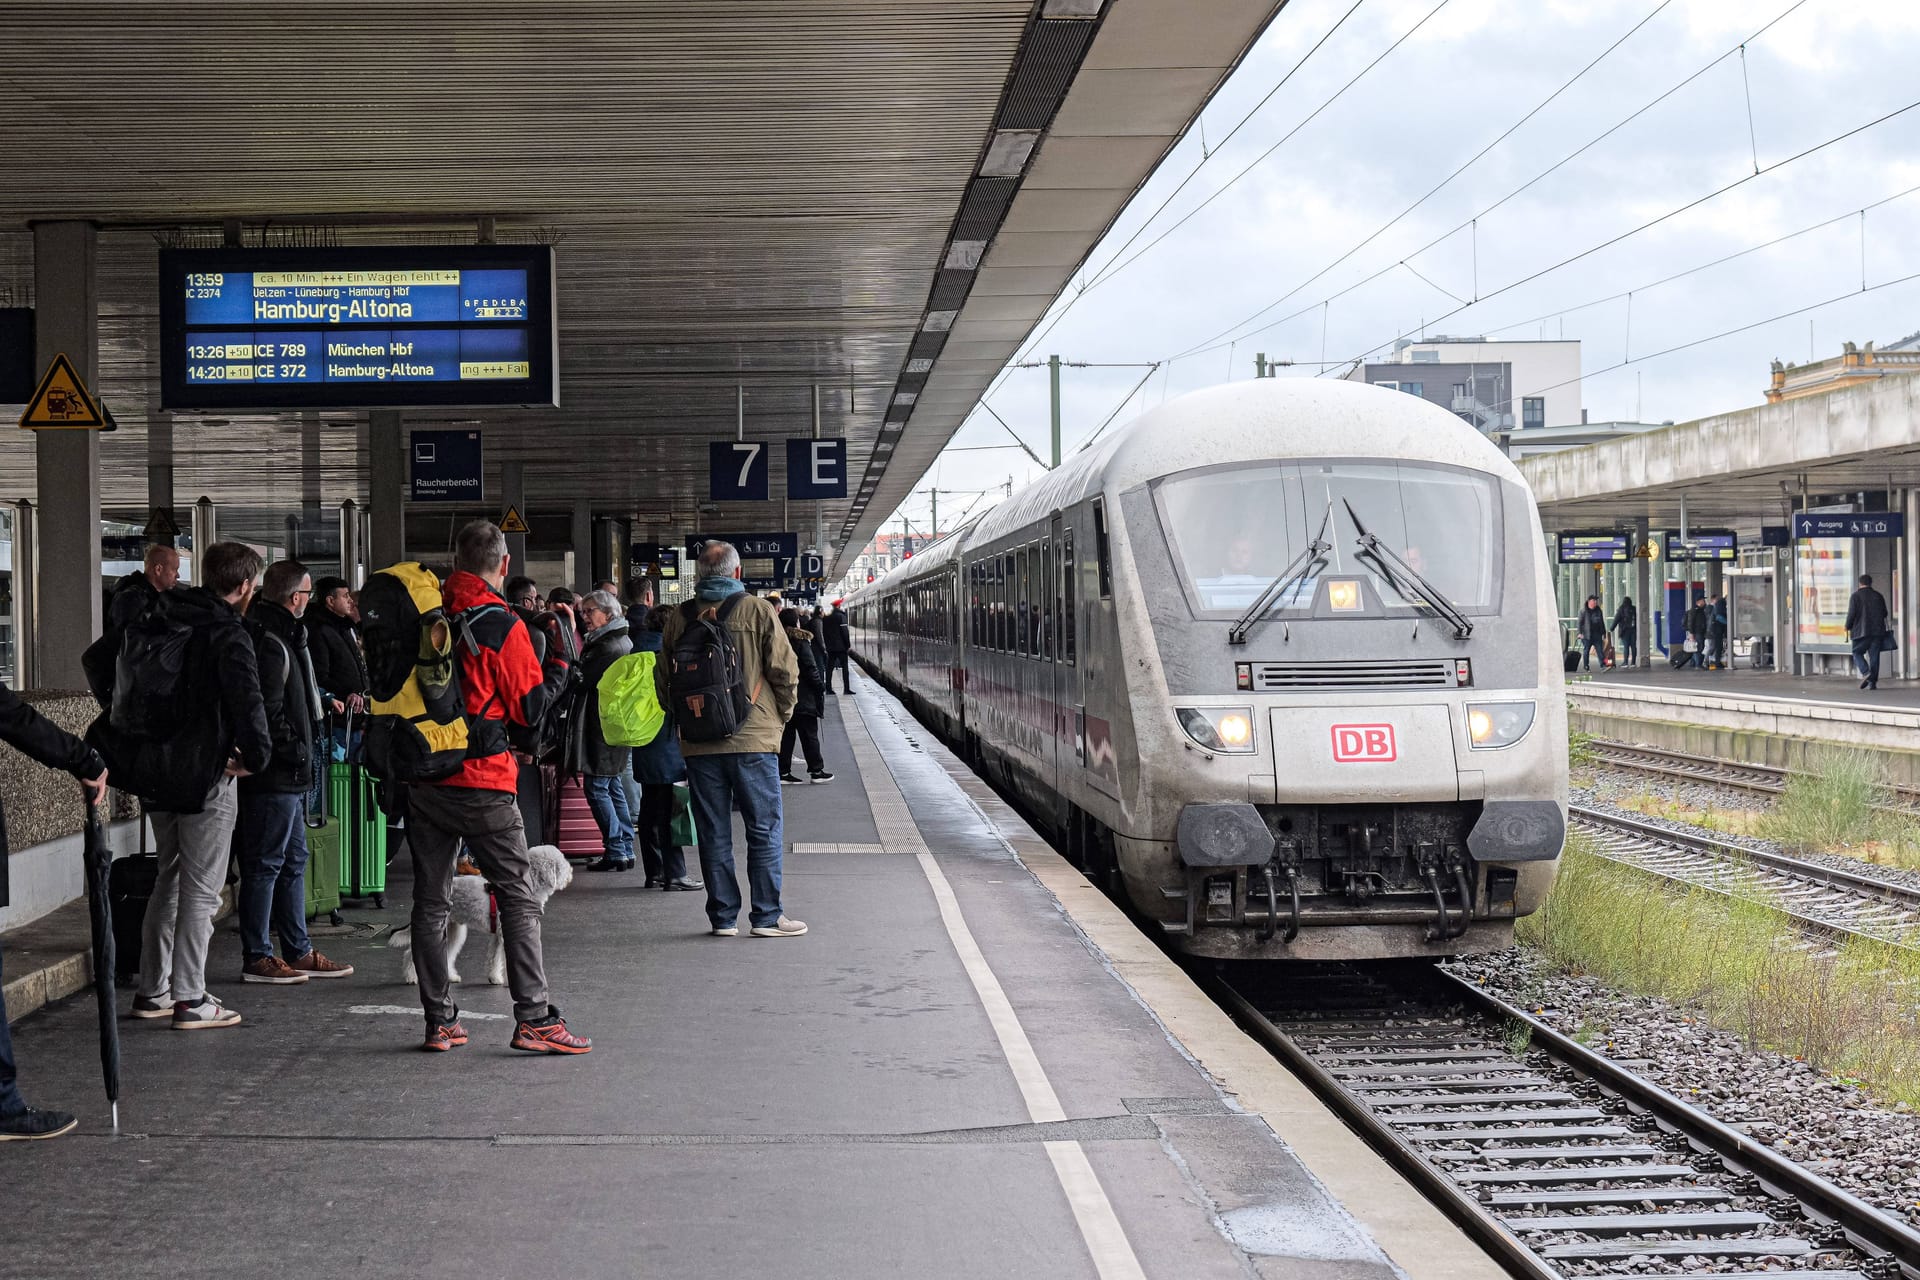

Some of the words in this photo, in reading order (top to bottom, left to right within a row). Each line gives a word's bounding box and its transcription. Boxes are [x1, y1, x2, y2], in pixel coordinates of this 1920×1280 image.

[186, 273, 223, 287] 13:59
[260, 274, 276, 283] ca.
[281, 273, 293, 283] 10
[297, 273, 319, 283] Min.
[347, 272, 364, 282] Ein
[367, 272, 408, 284] Wagen
[411, 272, 441, 282] fehlt
[186, 288, 195, 298] IC
[197, 288, 221, 298] 2374
[253, 287, 286, 298] Uelzen
[295, 287, 340, 299] Lüneburg
[348, 286, 390, 299] Hamburg
[393, 286, 410, 296] Hbf
[254, 299, 412, 323] Hamburg-Altona
[187, 345, 224, 359] 13:26
[229, 347, 249, 357] +50
[254, 344, 275, 357] ICE
[280, 344, 306, 357] 789
[328, 343, 385, 356] München
[390, 342, 413, 355] Hbf
[187, 366, 225, 379] 14:20
[229, 368, 249, 377] +10
[254, 365, 275, 378] ICE
[280, 365, 306, 378] 372
[328, 363, 434, 379] Hamburg-Altona
[507, 363, 528, 374] Fah
[732, 443, 760, 487] 7
[811, 441, 839, 484] E
[416, 478, 479, 487] Raucherbereich
[1817, 521, 1843, 529] Ausgang
[781, 557, 793, 573] 7
[808, 556, 821, 573] D
[809, 580, 818, 590] C
[1339, 730, 1389, 756] DB
